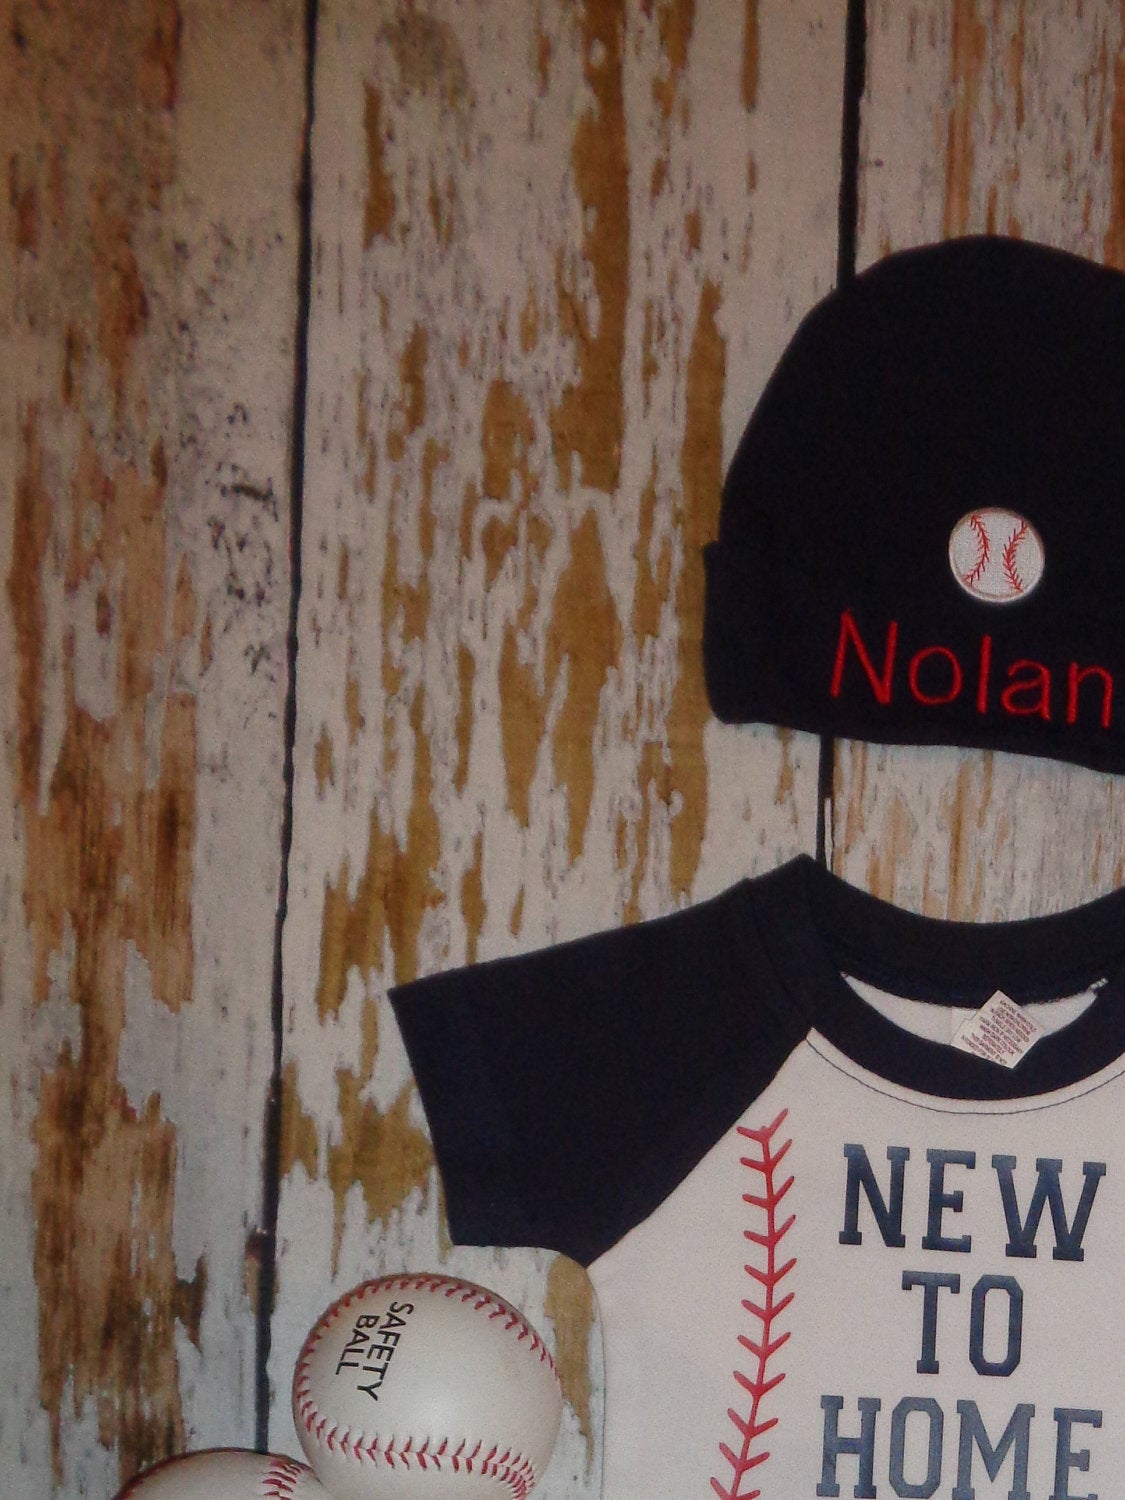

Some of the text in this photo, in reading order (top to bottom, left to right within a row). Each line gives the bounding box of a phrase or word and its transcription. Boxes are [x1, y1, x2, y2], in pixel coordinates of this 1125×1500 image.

[830, 609, 1114, 729] Nolan
[838, 1143, 1107, 1262] NEW
[335, 1314, 380, 1375] BALL
[356, 1301, 414, 1401] SAFETY
[902, 1270, 1024, 1378] TO
